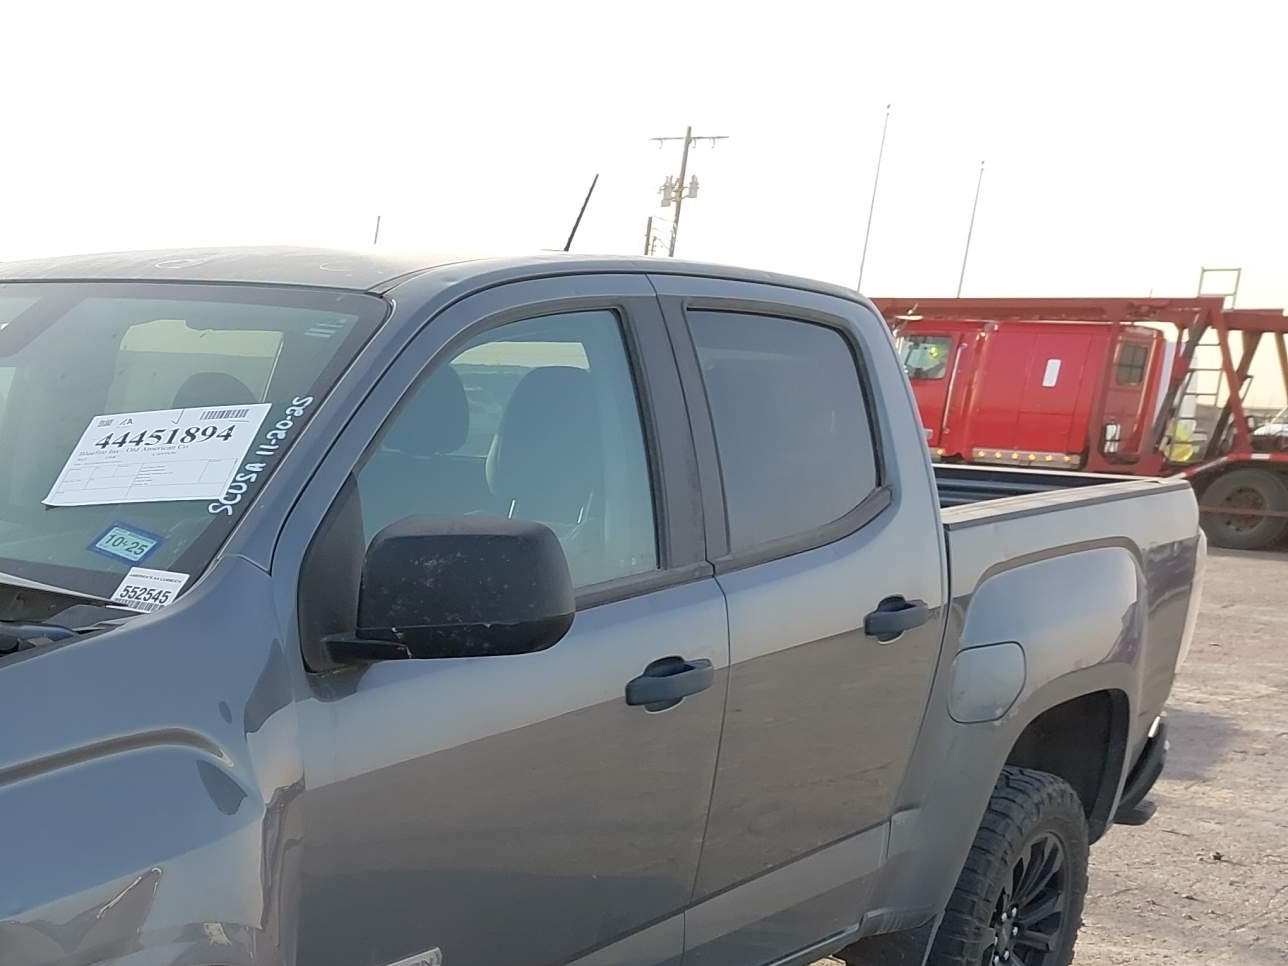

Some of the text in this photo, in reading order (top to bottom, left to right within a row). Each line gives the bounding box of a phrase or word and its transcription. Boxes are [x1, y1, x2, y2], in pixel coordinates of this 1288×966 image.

[95, 424, 236, 449] 44451894
[208, 462, 268, 517] SCUSA
[119, 585, 171, 604] 552545
